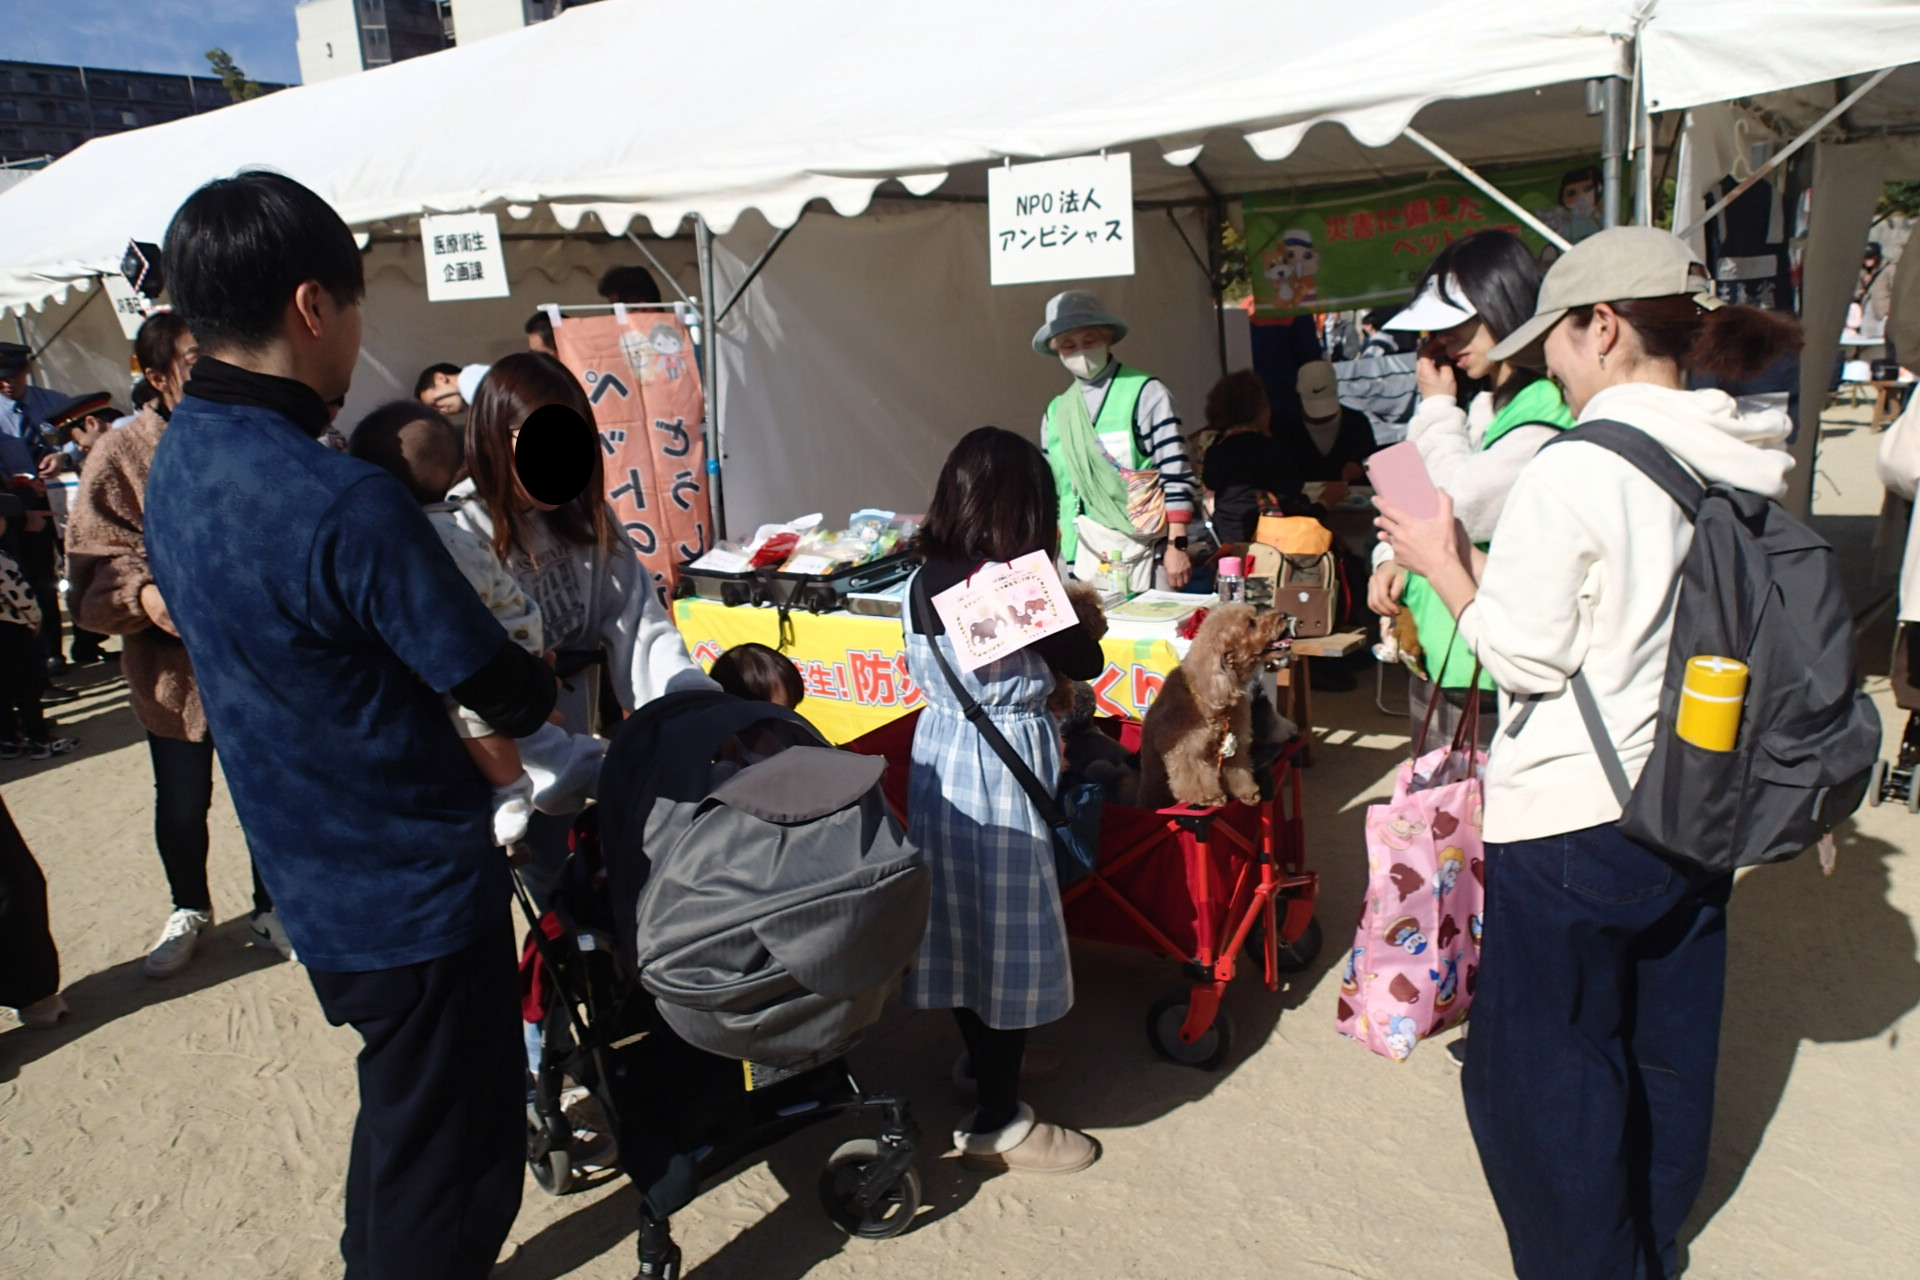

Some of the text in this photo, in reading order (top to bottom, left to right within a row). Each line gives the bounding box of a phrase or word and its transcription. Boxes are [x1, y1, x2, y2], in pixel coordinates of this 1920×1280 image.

[999, 219, 1123, 252] アンビシャス
[1325, 196, 1485, 244] 災害に備えた
